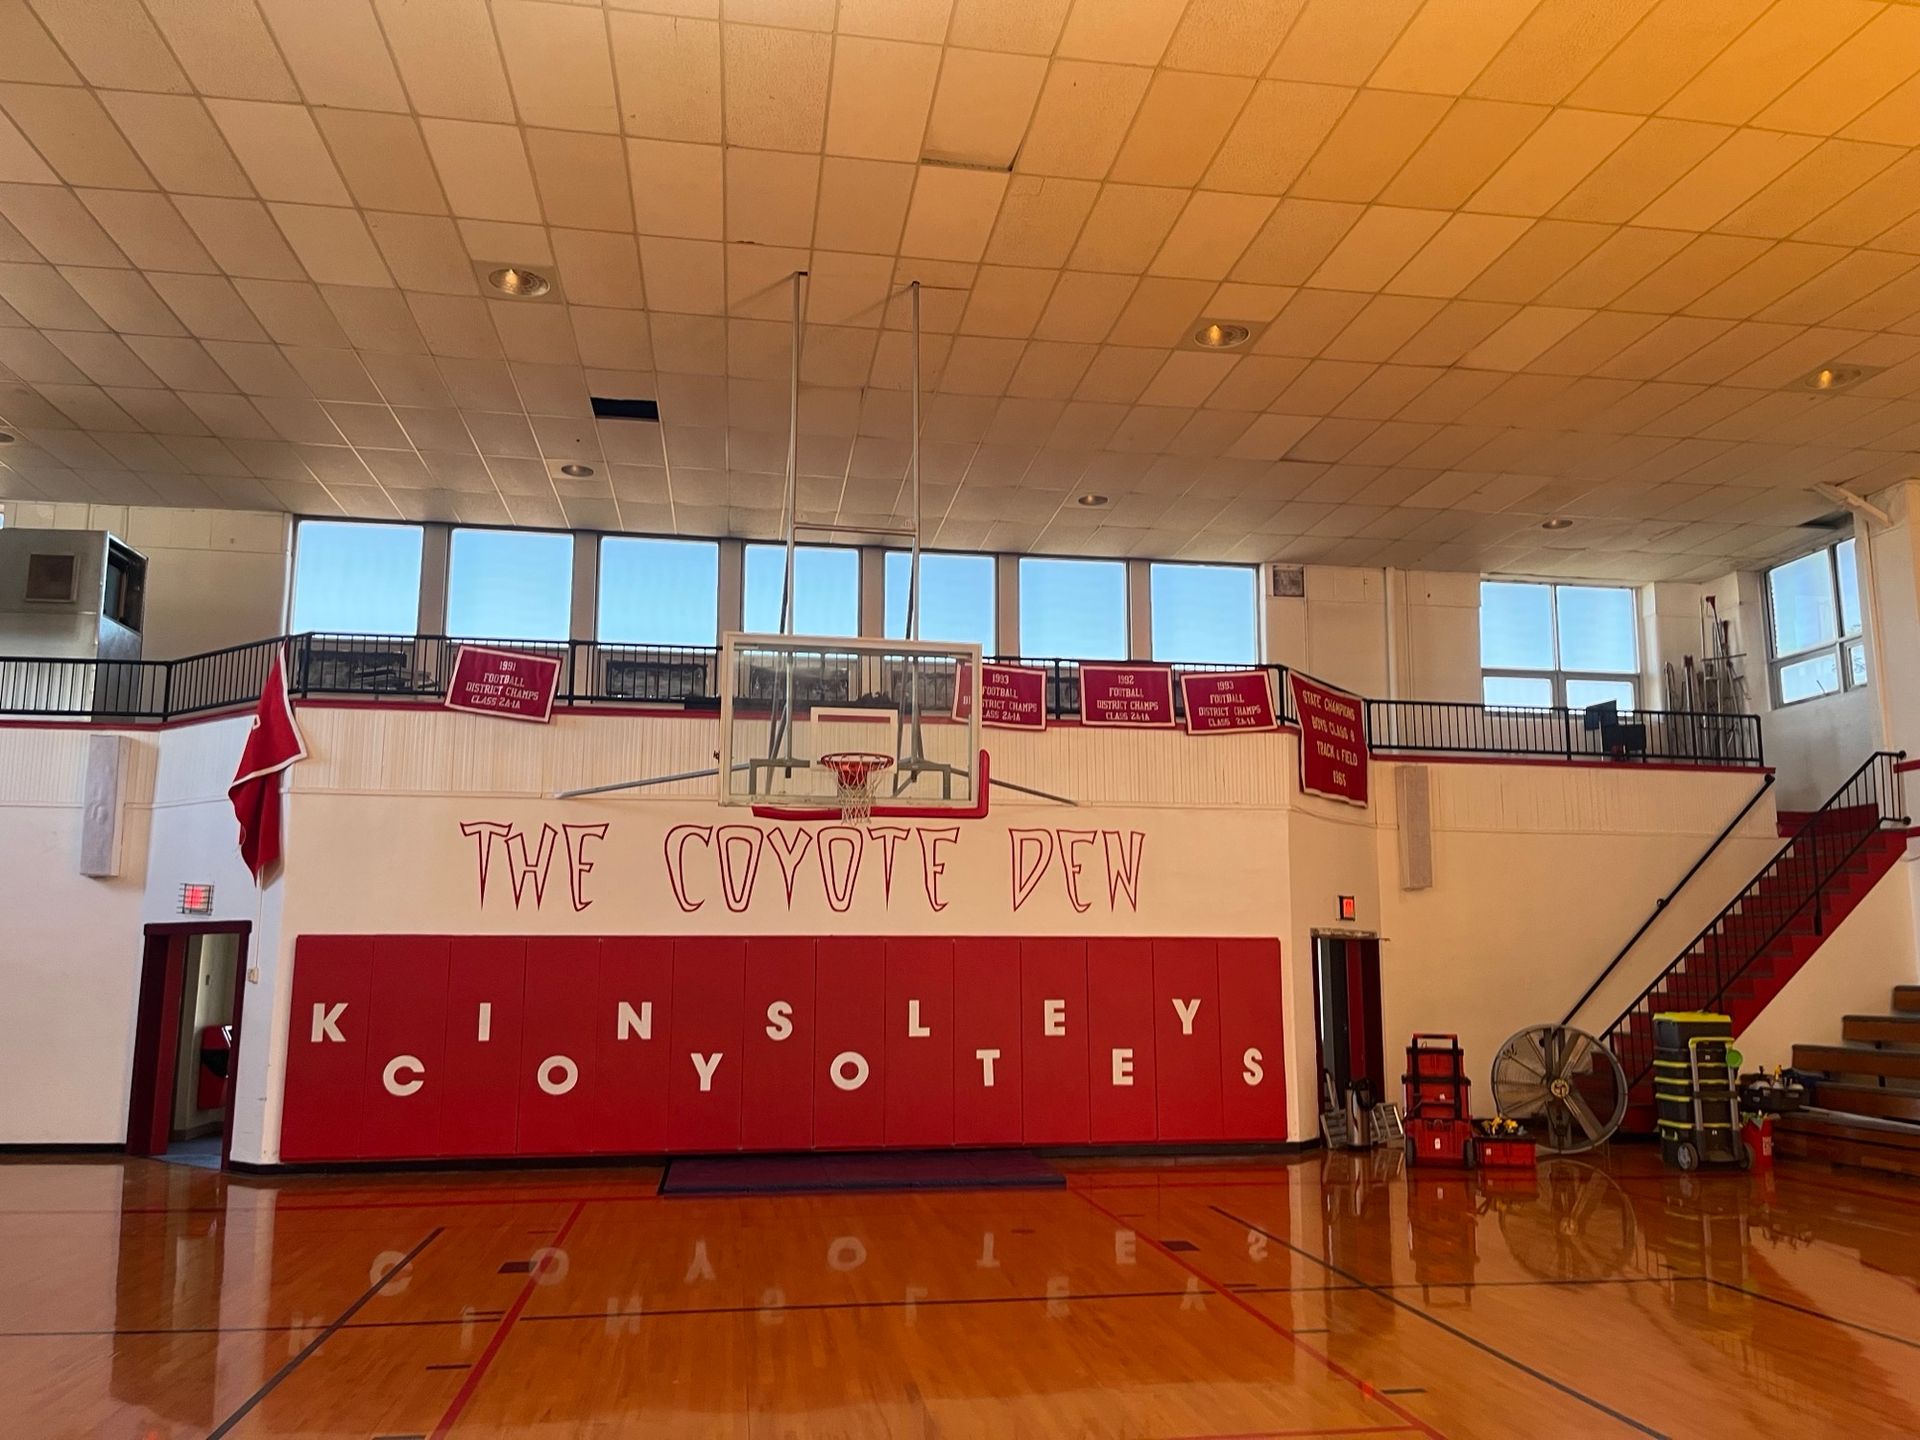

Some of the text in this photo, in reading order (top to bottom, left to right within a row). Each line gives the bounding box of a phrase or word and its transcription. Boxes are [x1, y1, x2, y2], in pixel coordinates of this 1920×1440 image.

[483, 672, 525, 687] FOOTBALL
[465, 682, 539, 701] DISTRICT CHAMPS
[982, 686, 1018, 699] FOOTBALL
[1108, 687, 1145, 698] FOOTBALL
[470, 695, 497, 706] CLASS
[1096, 699, 1159, 711] DISTRICT CHAMPS
[1209, 693, 1245, 704] FOOTBALL
[1302, 689, 1356, 721] STATE CHAMPIONS
[1008, 702, 1038, 713] CHAMPS
[1198, 704, 1262, 717] DISTRICT CHAMPS
[1105, 711, 1129, 721] CLASS
[1207, 718, 1231, 728] CLASS
[1311, 715, 1328, 734] BOYS
[1328, 721, 1349, 741] CLASS
[1316, 740, 1335, 759] TRACK
[1341, 748, 1358, 767] FIELD
[460, 821, 609, 911] THE
[664, 824, 960, 912] COYOTE
